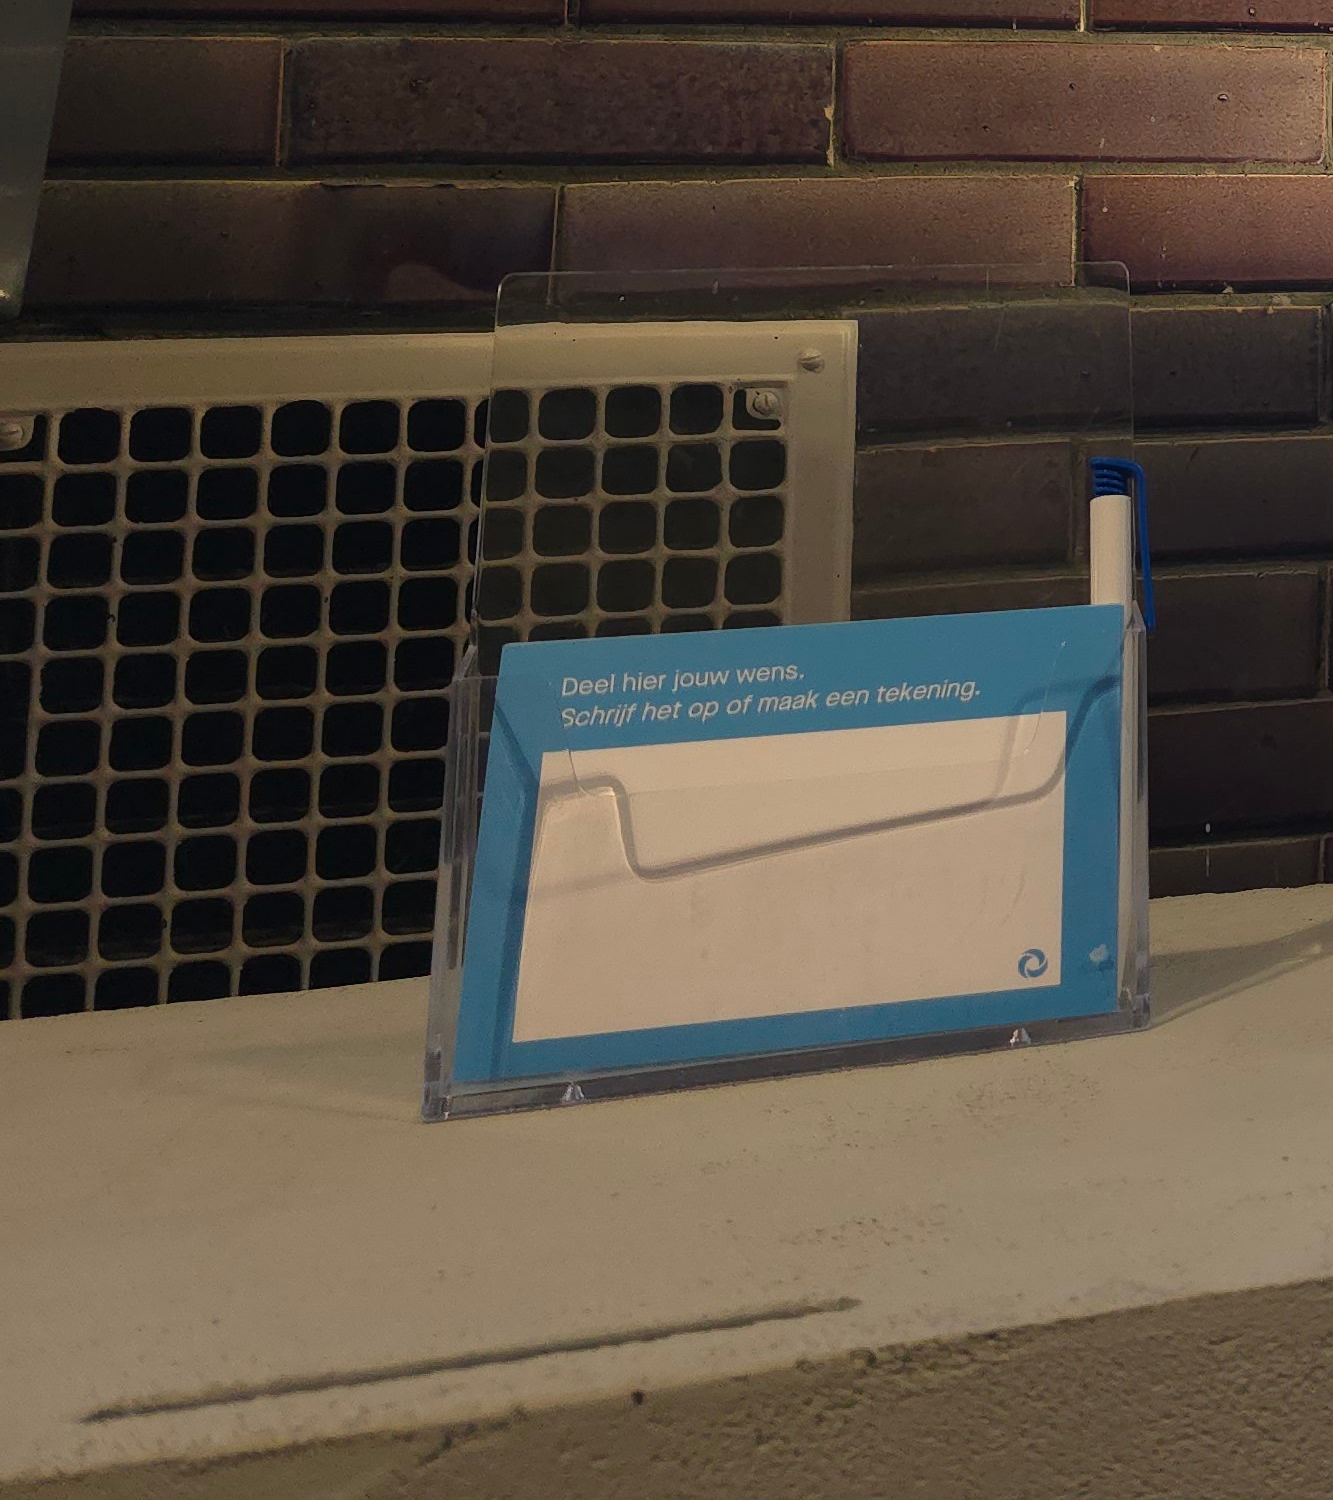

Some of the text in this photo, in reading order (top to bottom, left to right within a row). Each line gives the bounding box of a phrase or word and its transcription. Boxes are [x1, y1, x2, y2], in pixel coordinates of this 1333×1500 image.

[561, 664, 805, 697] Deel hier jouw wens.
[561, 679, 981, 728] Schrijf het op of maak een tekening.
